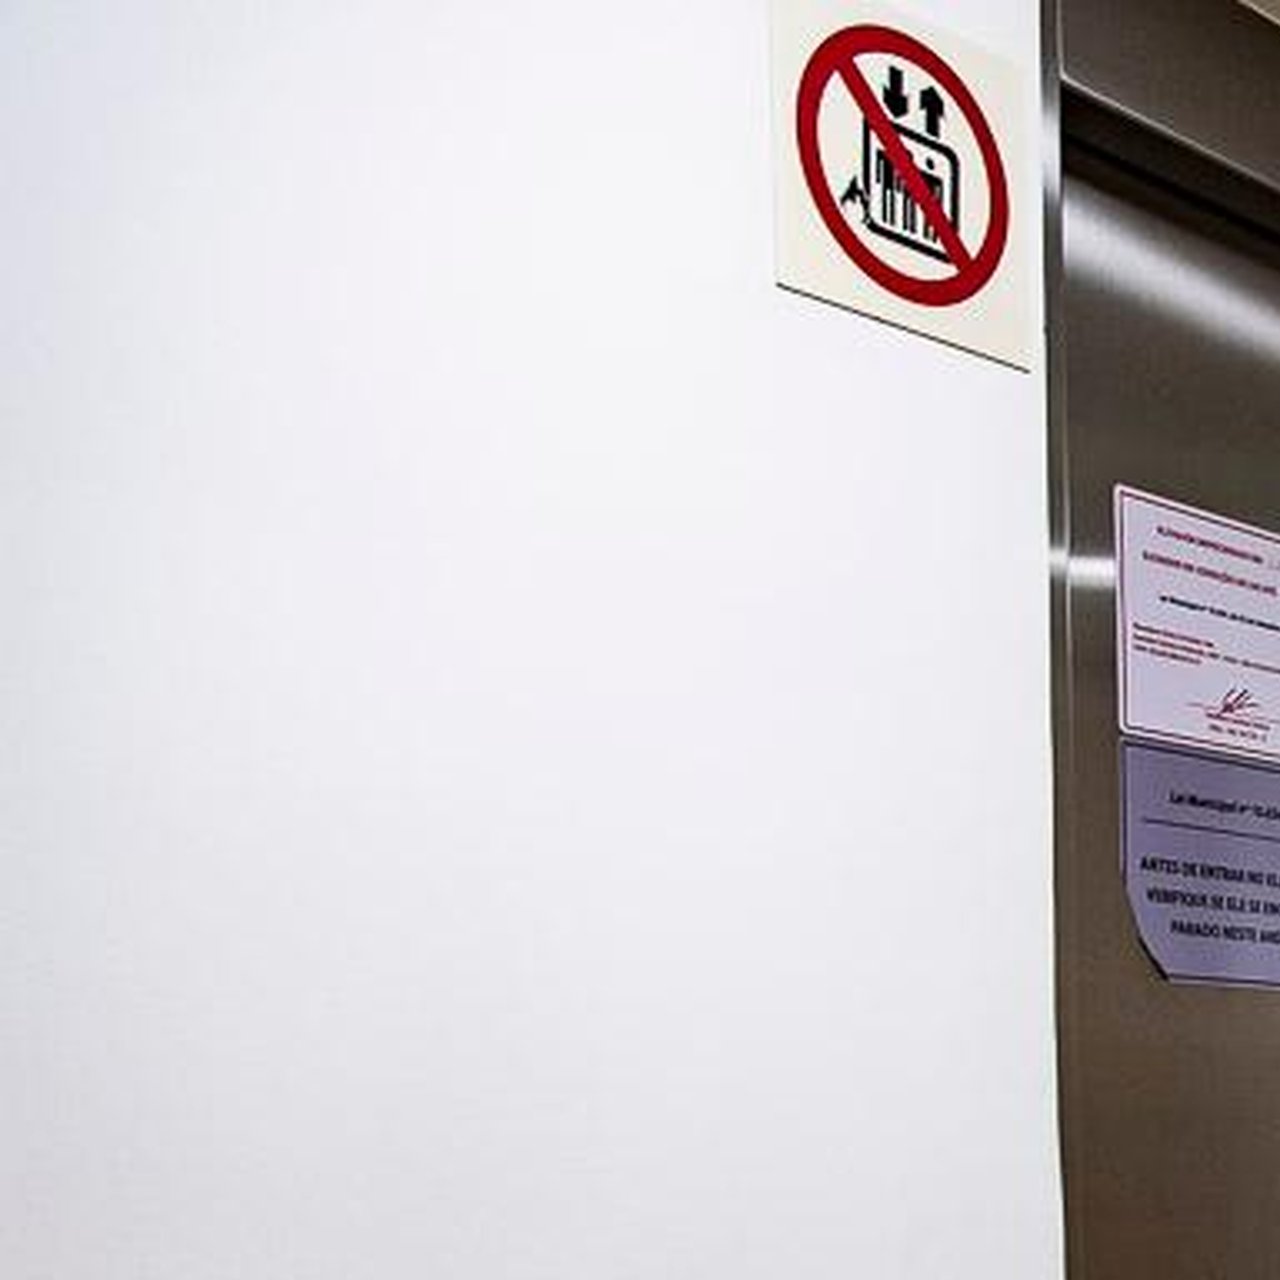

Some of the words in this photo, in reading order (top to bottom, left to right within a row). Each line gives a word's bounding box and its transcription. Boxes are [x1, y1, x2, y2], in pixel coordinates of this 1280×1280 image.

[1140, 856, 1178, 875] ANTES
[1181, 861, 1197, 877] DE
[1200, 863, 1244, 883] ENTRAR
[1247, 870, 1263, 886] NO
[1147, 887, 1207, 908] VERIFIQUE
[1211, 894, 1224, 910] SE
[1226, 896, 1245, 912] ELE
[1249, 898, 1260, 913] SE
[1170, 919, 1220, 938] PARADO
[1223, 925, 1257, 942] NESTE
